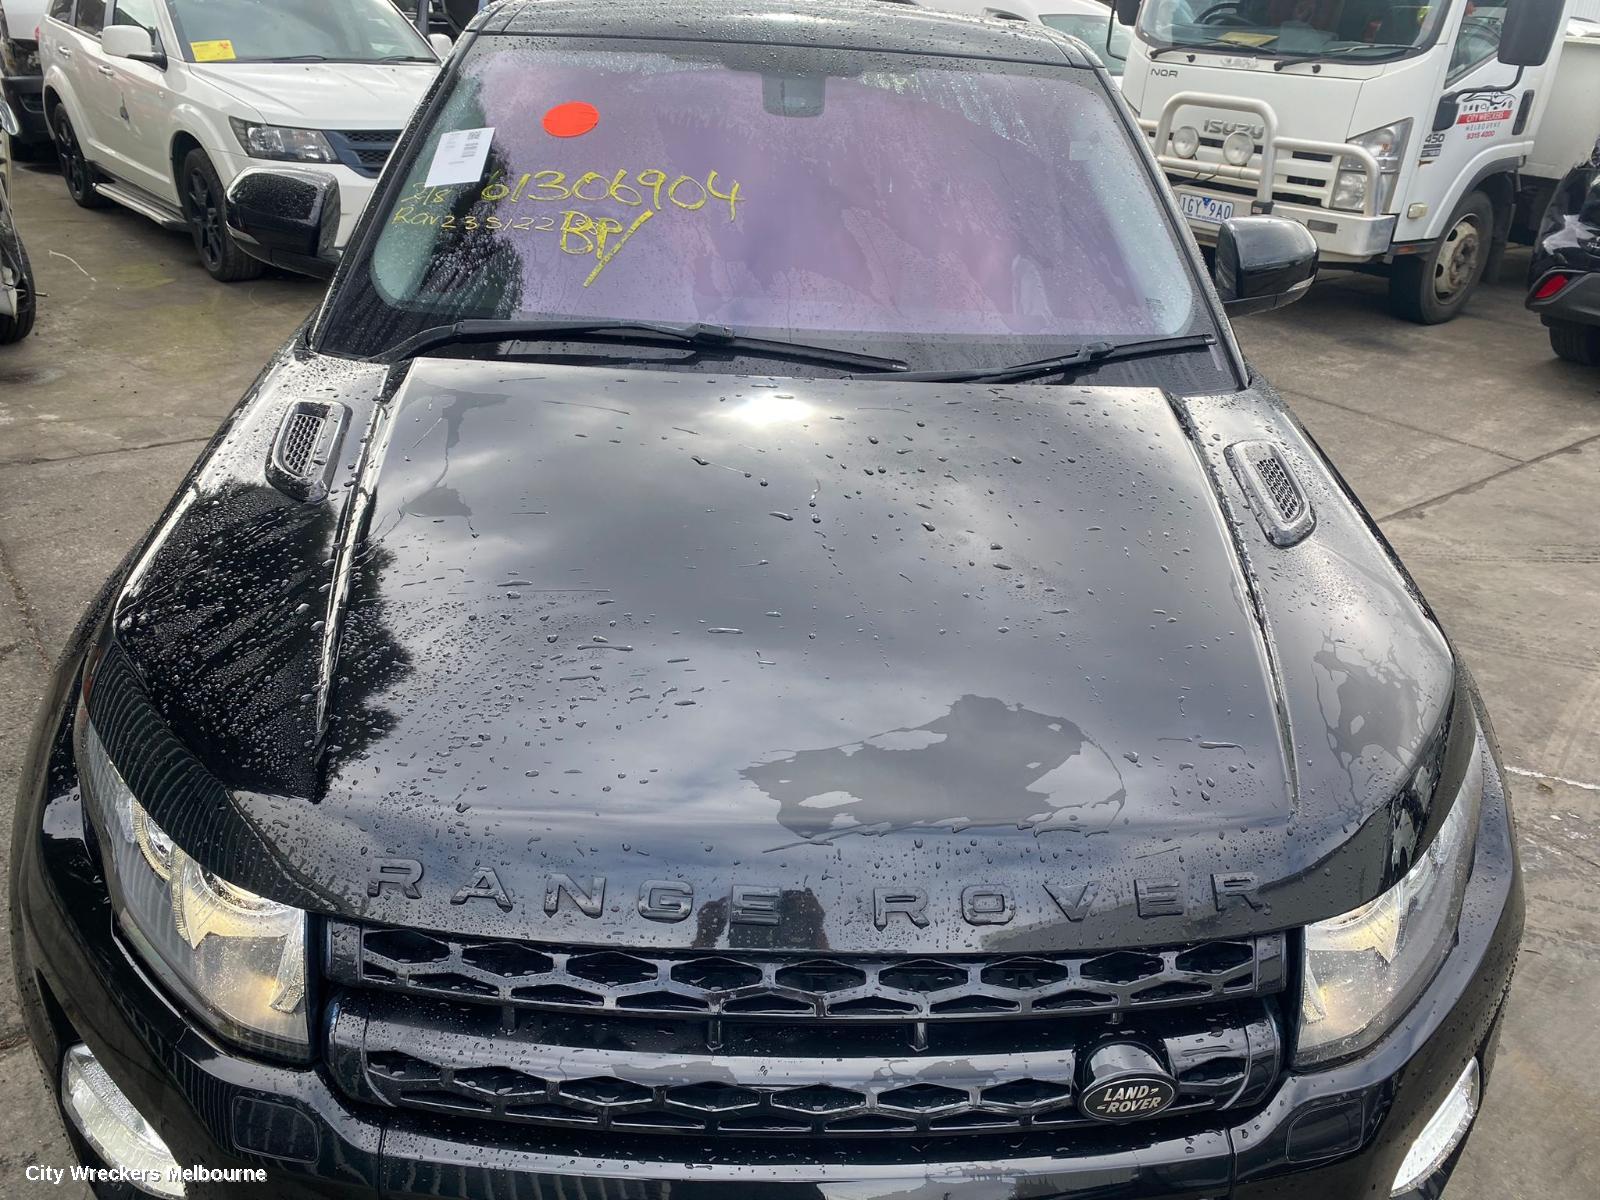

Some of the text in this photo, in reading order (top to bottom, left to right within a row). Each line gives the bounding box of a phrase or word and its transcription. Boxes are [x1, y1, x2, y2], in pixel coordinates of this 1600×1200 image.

[1150, 68, 1178, 78] NQR
[1203, 119, 1265, 140] ISUZU
[1425, 133, 1445, 143] 450
[367, 858, 1265, 931] RANGE ROVER
